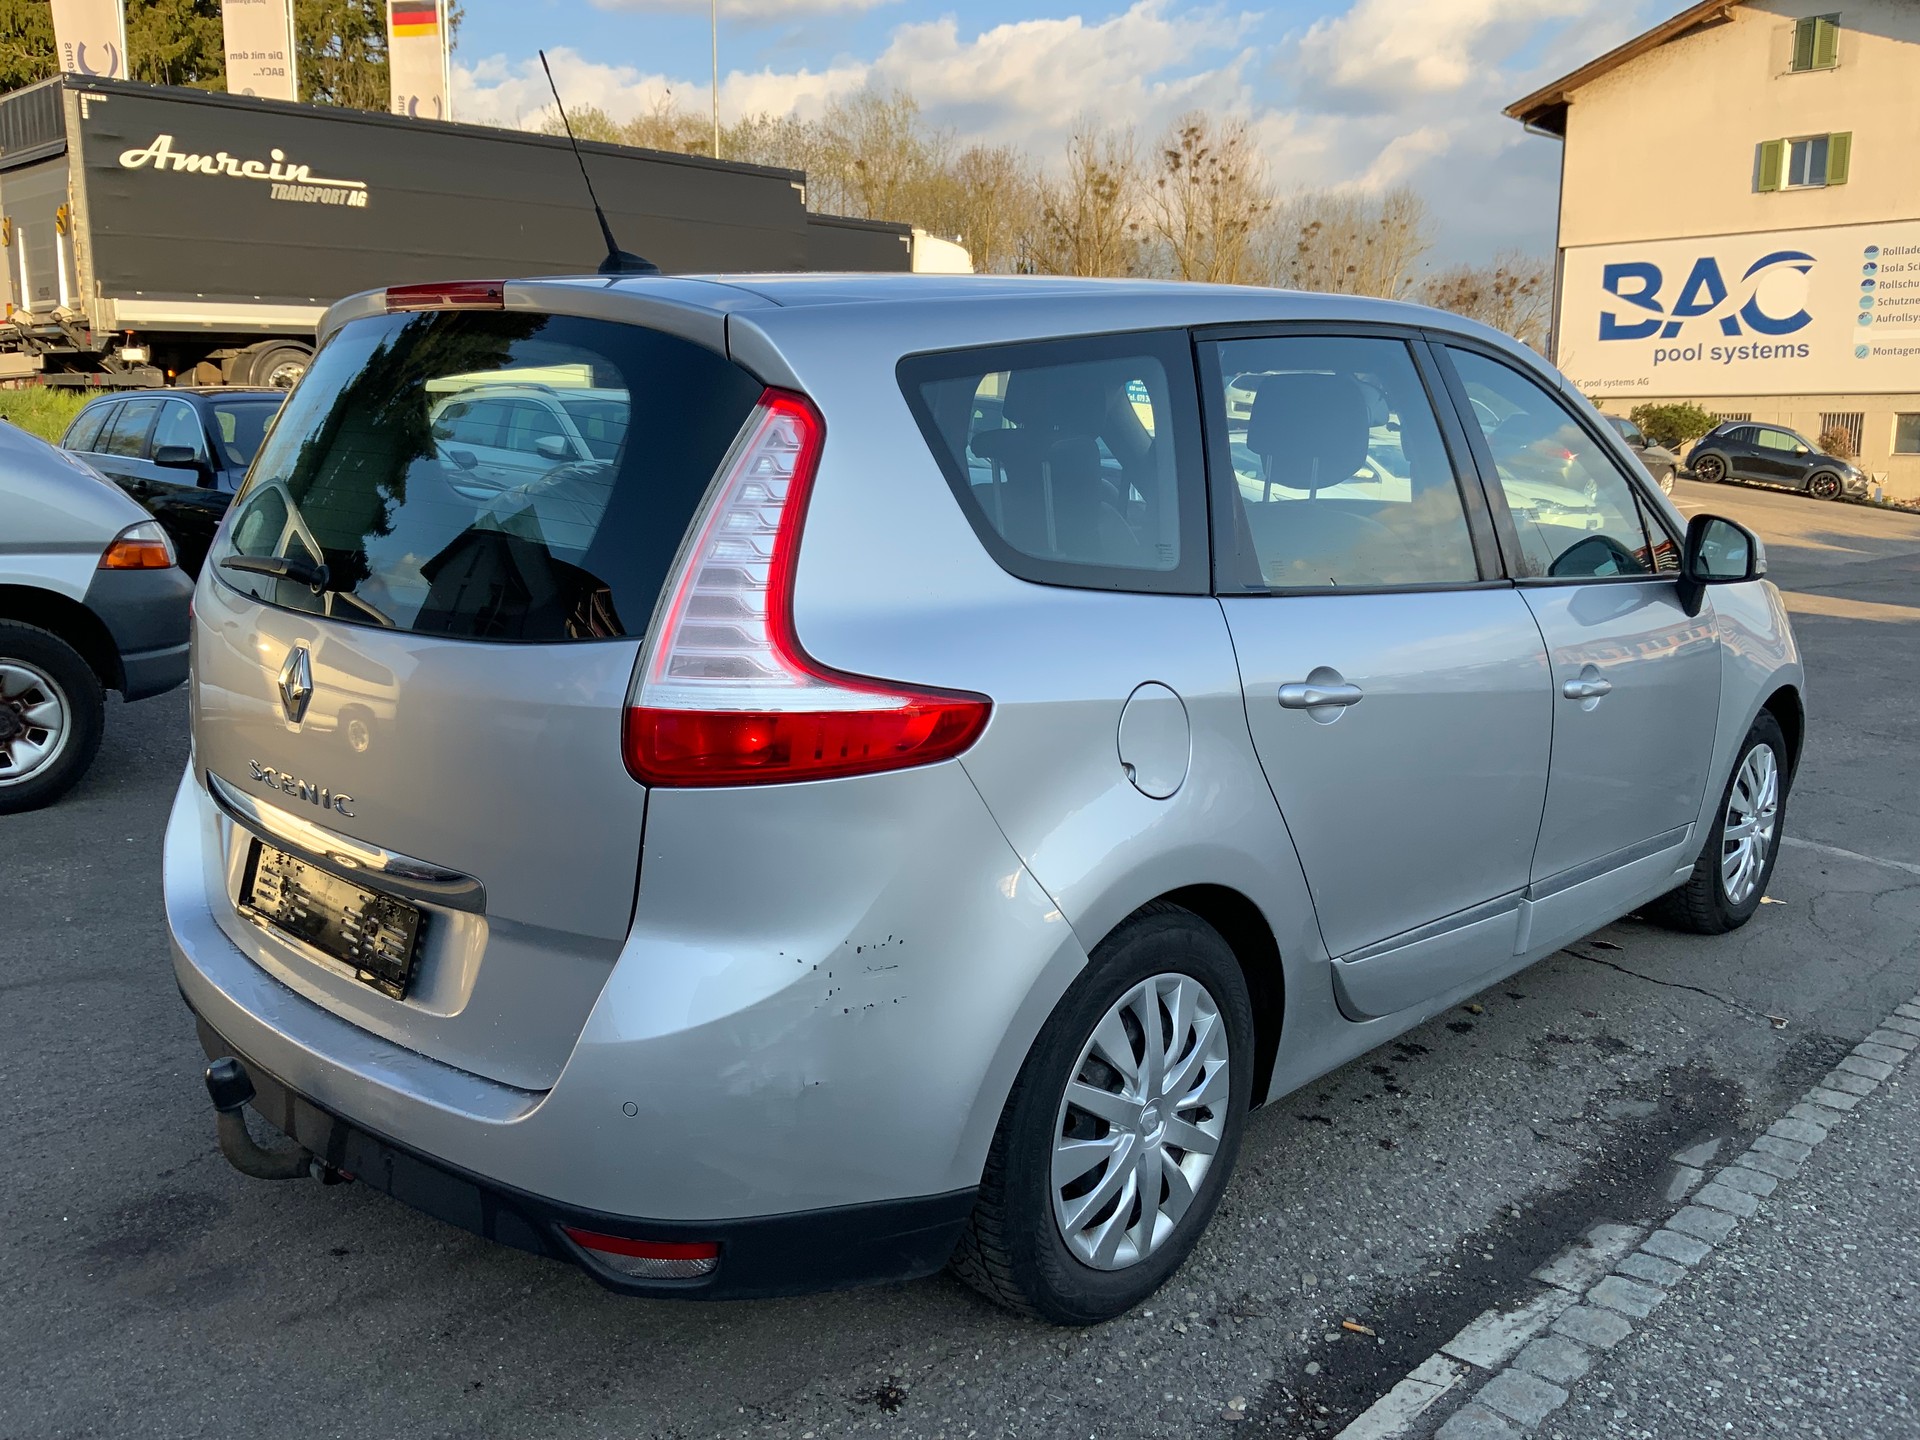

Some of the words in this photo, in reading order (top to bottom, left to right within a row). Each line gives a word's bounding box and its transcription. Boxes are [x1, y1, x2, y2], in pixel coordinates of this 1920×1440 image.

[119, 134, 311, 182] Amrein
[270, 183, 348, 206] TRANSPORT
[347, 190, 368, 208] AG
[1880, 263, 1905, 273] Isola
[1598, 250, 1818, 342] BAC
[1879, 279, 1920, 290] Rollschu
[1653, 342, 1703, 367] pool
[1709, 341, 1810, 365] systems
[1583, 378, 1602, 390] pool
[1603, 378, 1636, 389] systems
[1637, 377, 1650, 386] AG
[248, 759, 356, 818] SCENIC
